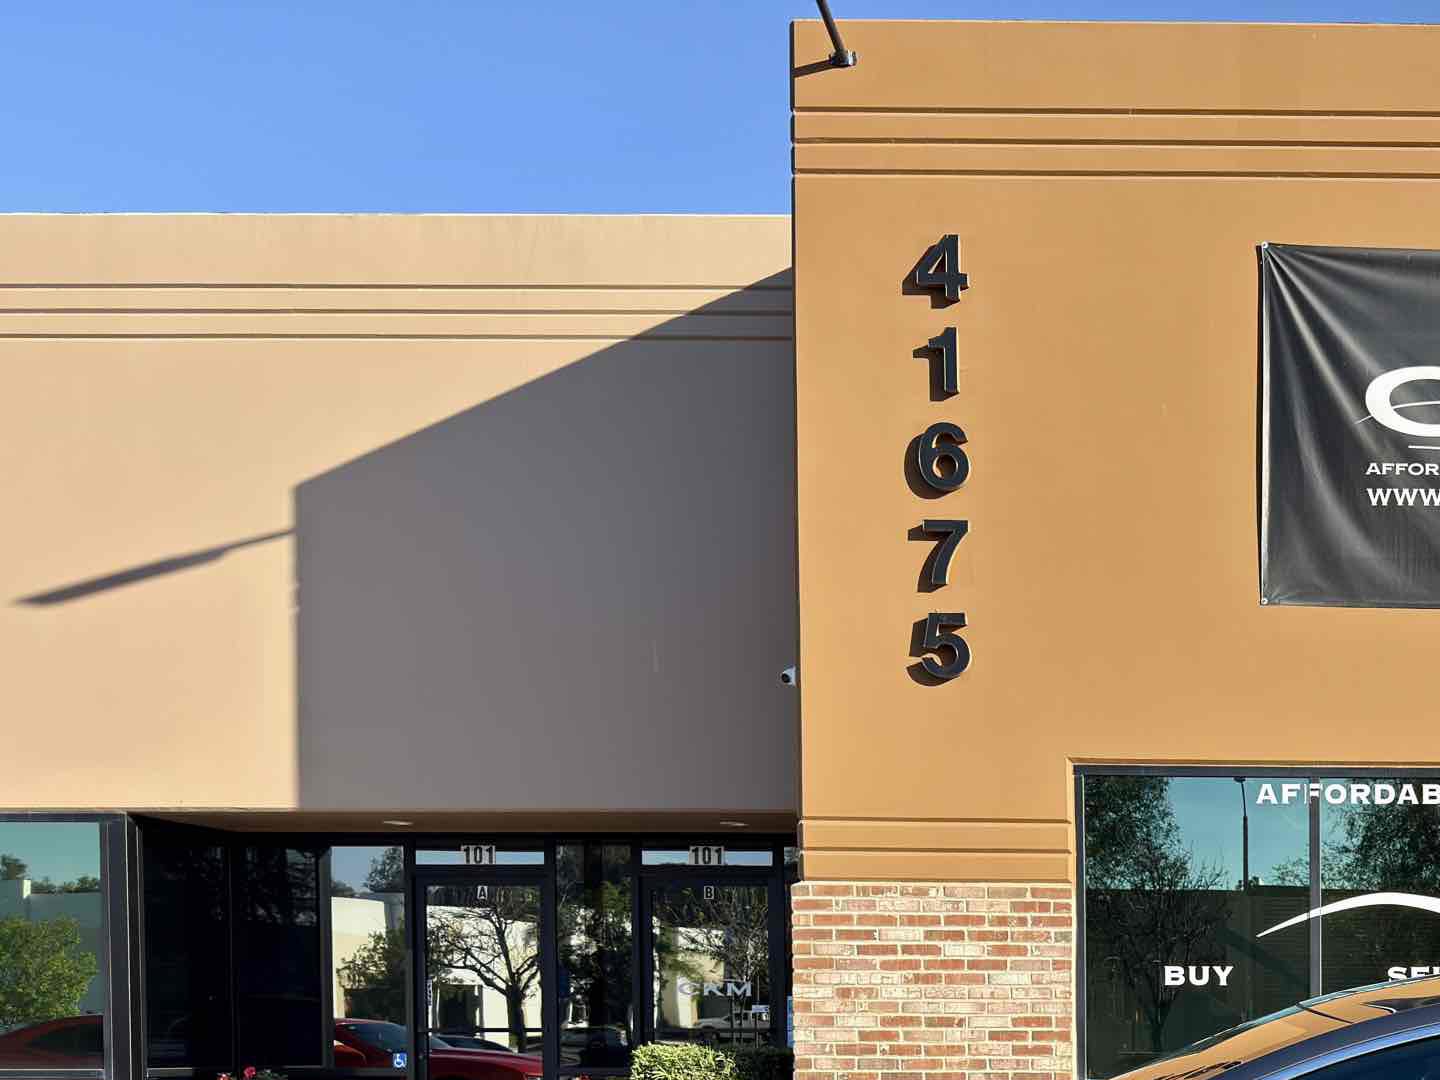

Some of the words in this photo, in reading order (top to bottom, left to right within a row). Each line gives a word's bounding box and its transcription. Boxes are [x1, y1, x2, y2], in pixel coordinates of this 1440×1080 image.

[907, 233, 971, 682] 41675
[463, 846, 495, 864] 101
[691, 846, 723, 865] 101
[478, 885, 487, 899] A
[704, 886, 714, 898] B
[1164, 965, 1233, 986] BUY
